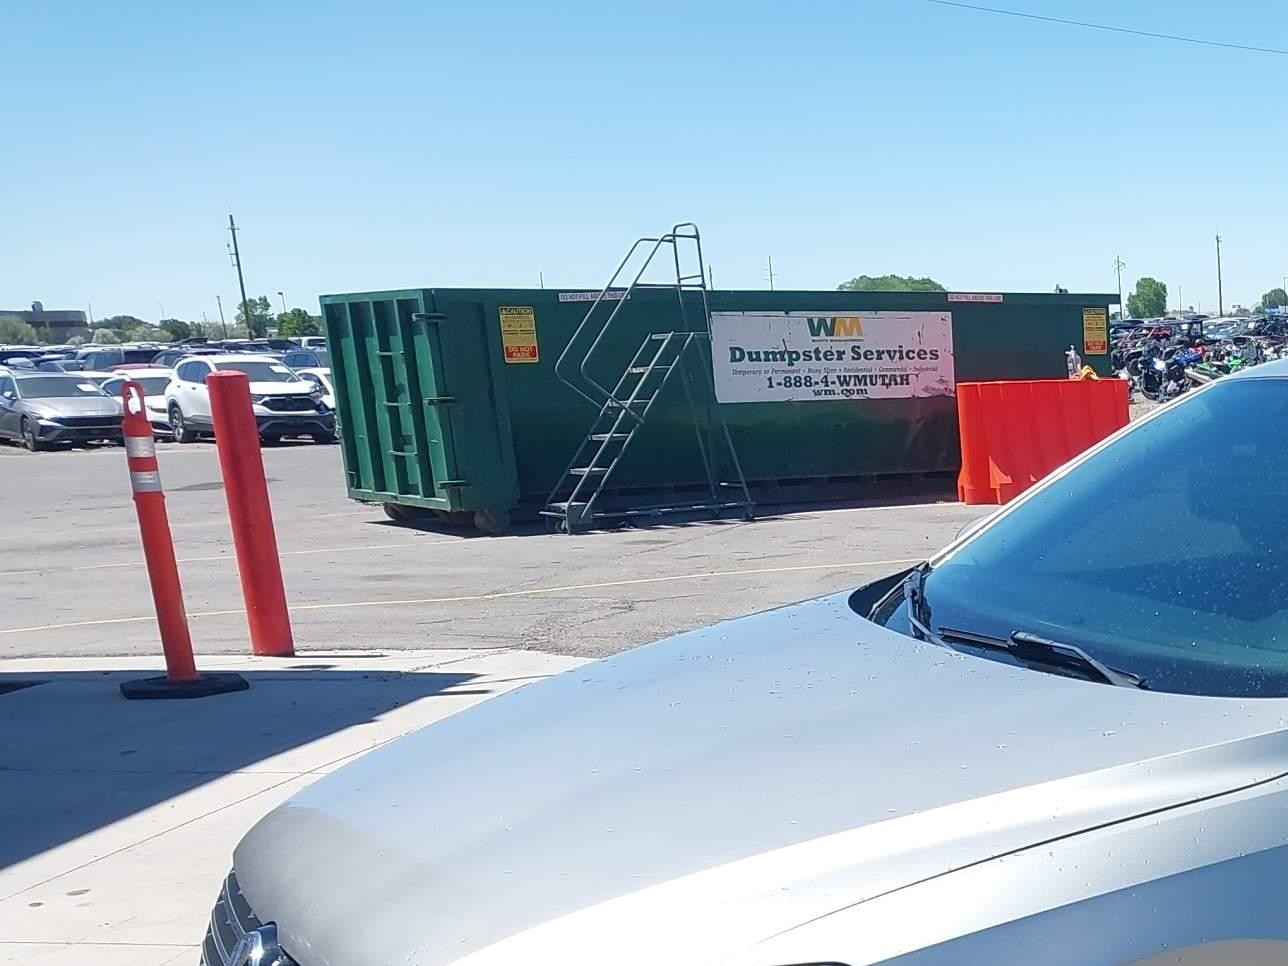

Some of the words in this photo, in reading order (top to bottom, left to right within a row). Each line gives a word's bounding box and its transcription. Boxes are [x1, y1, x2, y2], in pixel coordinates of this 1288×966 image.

[806, 317, 864, 337] WM
[728, 346, 846, 366] Dumpster
[851, 345, 939, 362] Services
[732, 368, 762, 376] Temporary
[771, 367, 801, 375] Permanent
[807, 367, 822, 375] Many
[767, 374, 910, 389] 1-888-4-WMUTAH
[812, 388, 868, 397] wm.com
